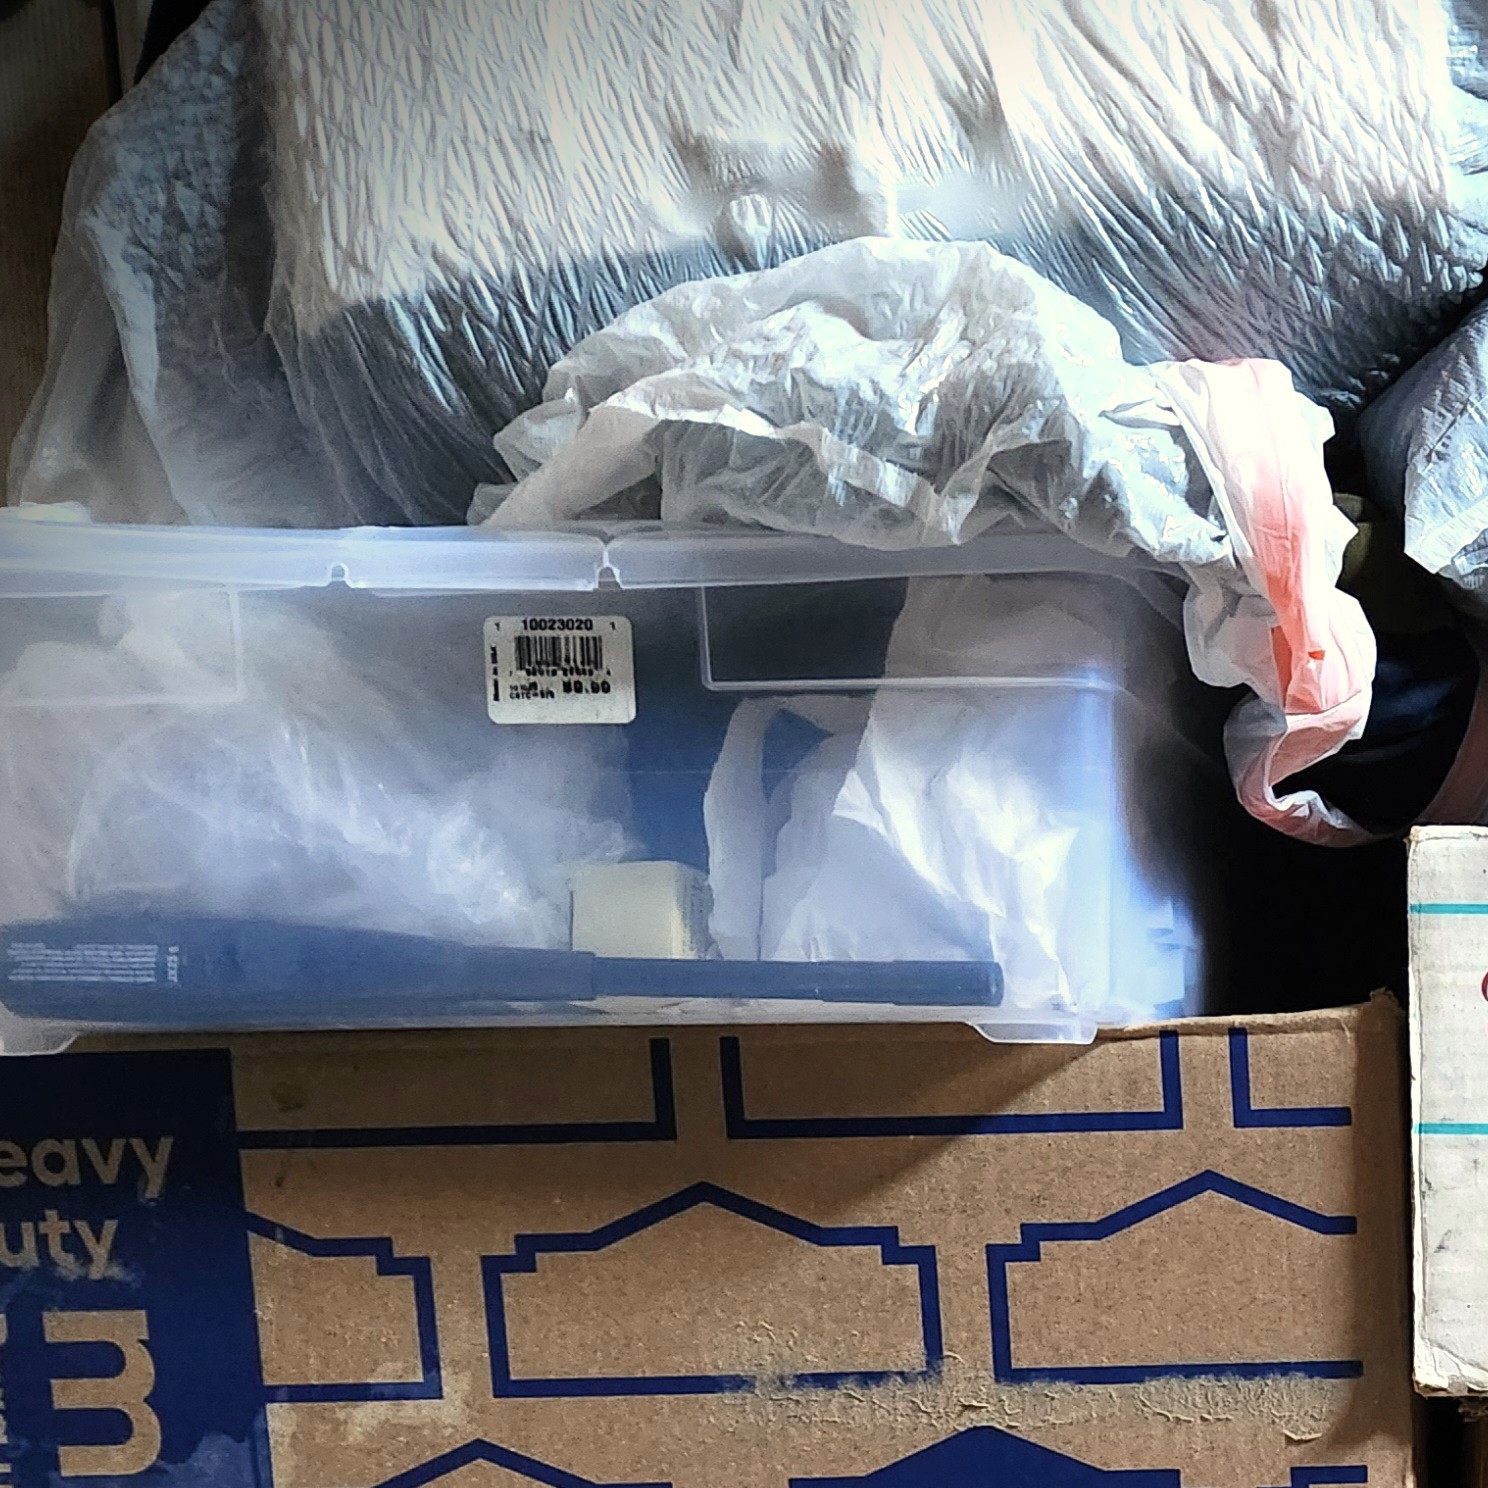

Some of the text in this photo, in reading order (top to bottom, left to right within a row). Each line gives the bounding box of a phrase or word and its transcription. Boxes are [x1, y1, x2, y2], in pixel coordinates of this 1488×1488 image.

[521, 618, 594, 631] 10023020
[0, 1135, 175, 1198] eavy
[0, 1209, 120, 1281] uty
